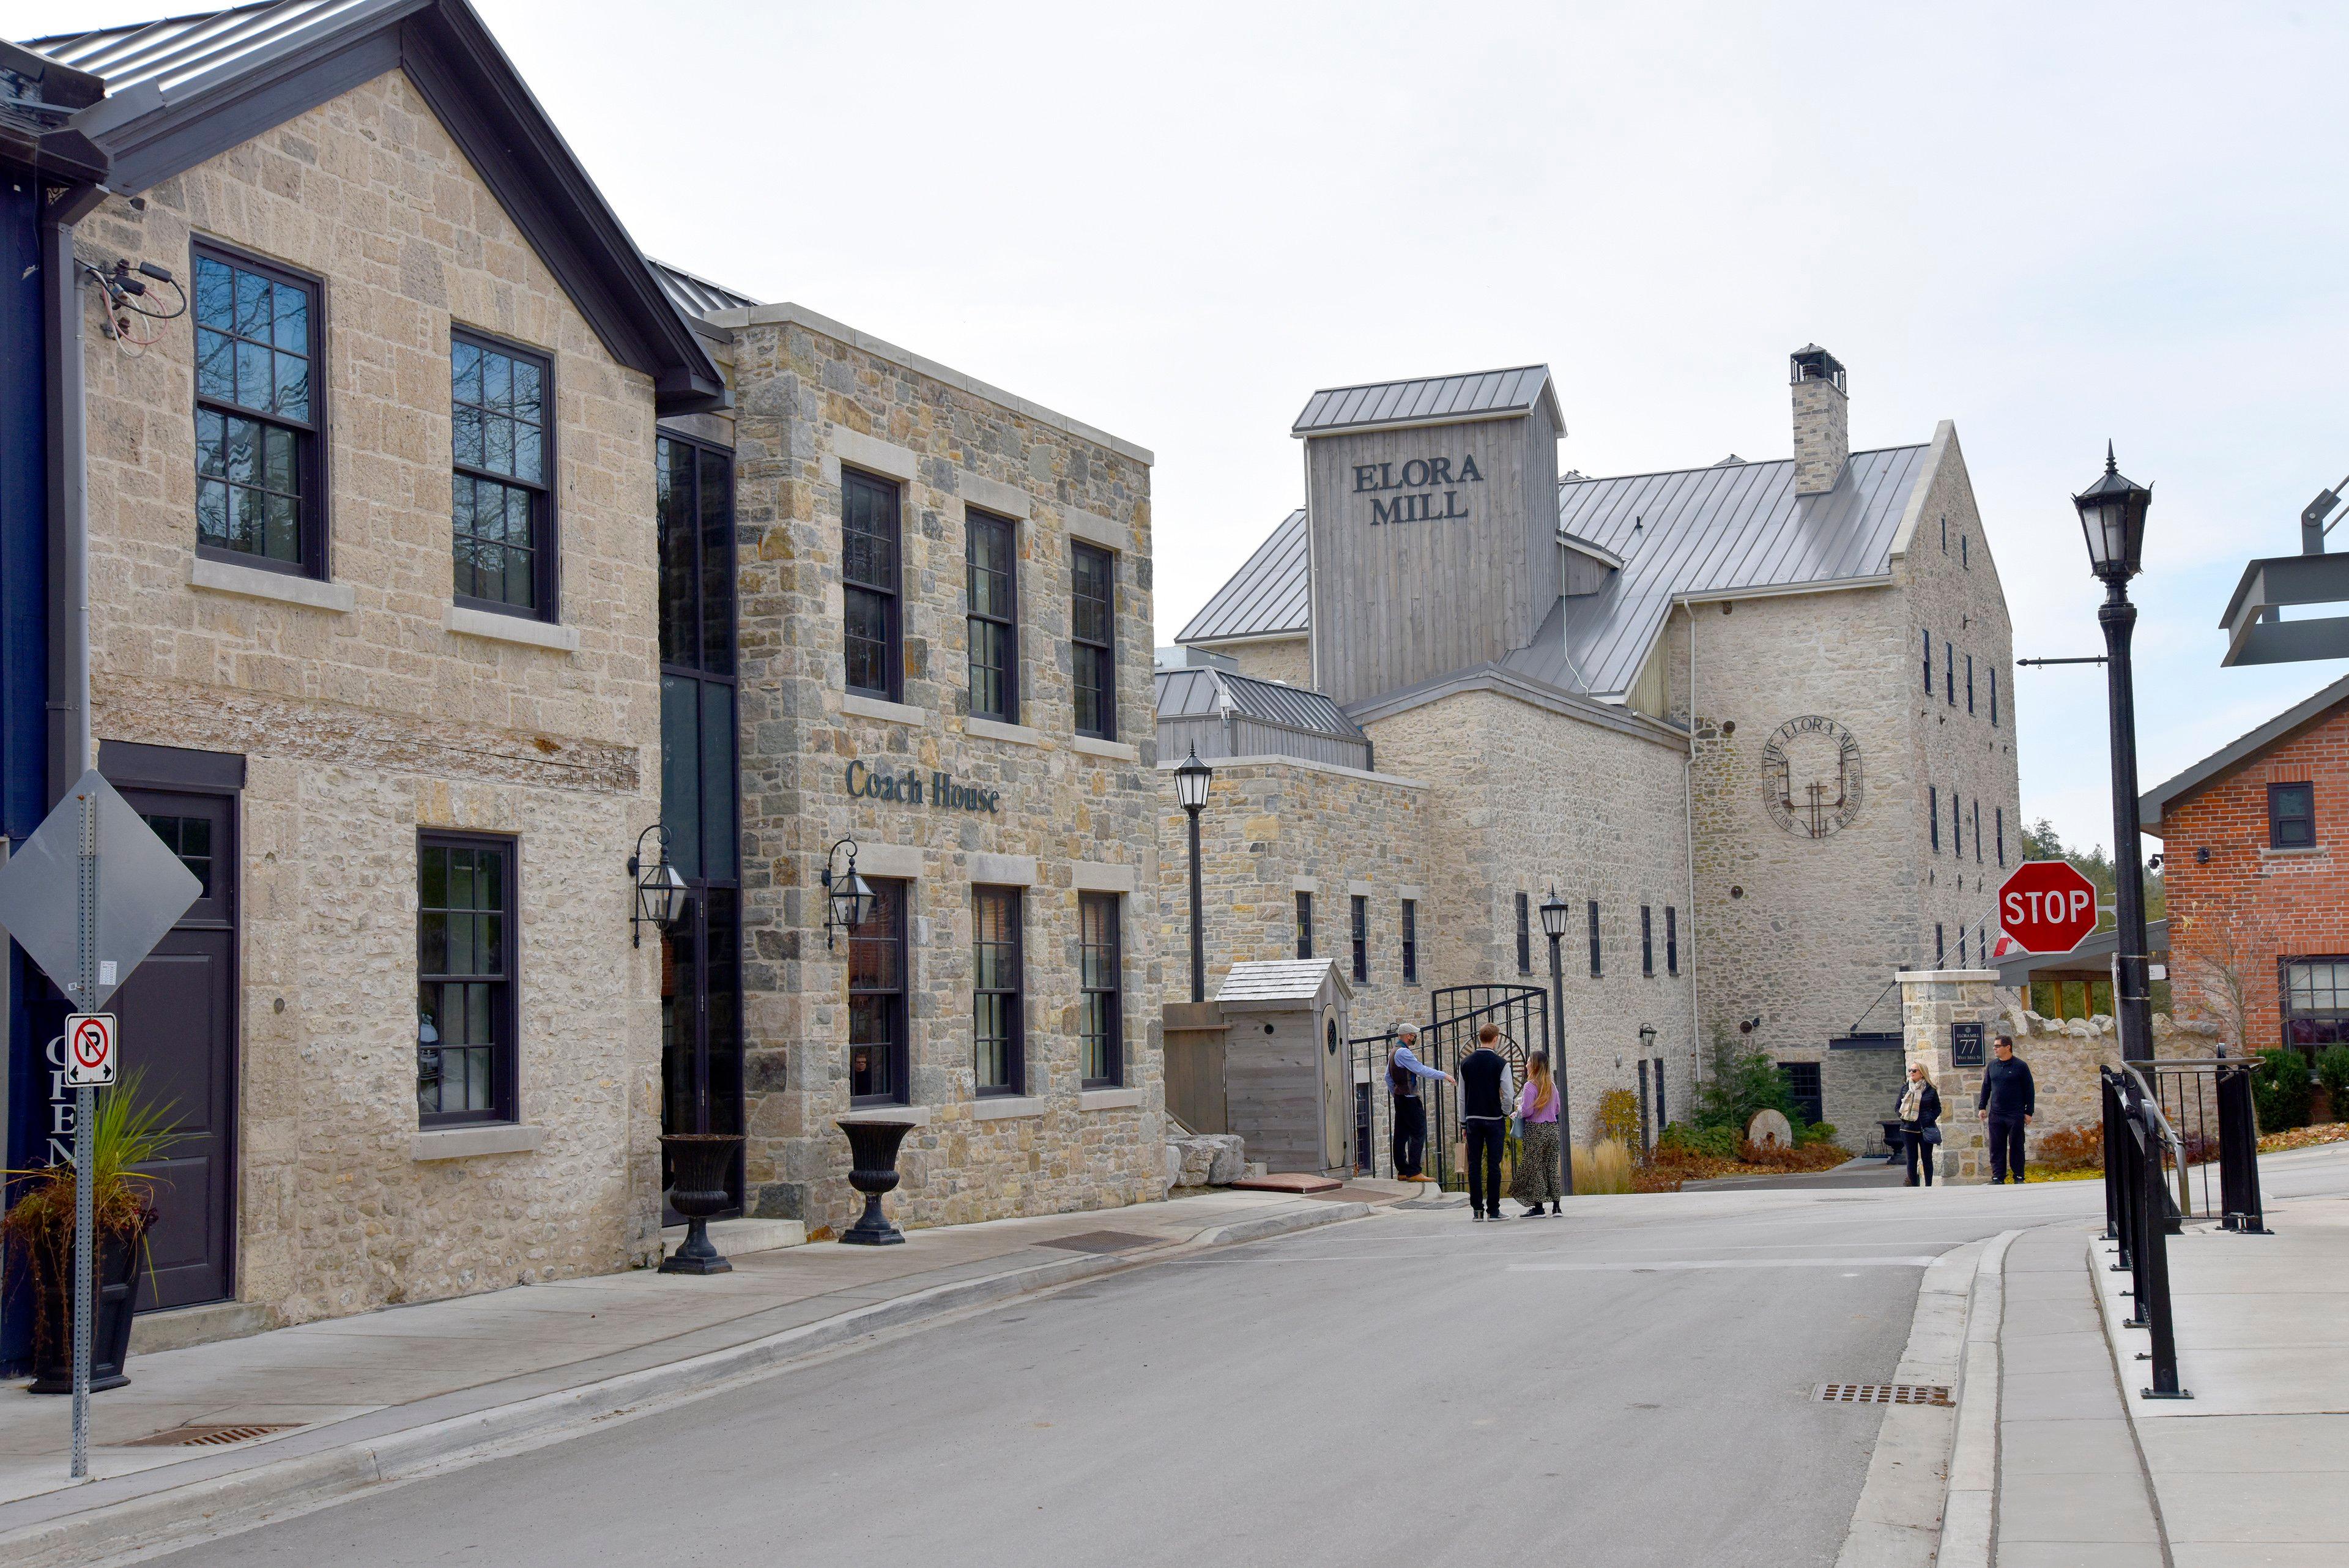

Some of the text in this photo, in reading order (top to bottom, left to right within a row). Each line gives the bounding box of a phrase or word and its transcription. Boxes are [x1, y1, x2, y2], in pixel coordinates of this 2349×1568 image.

[1352, 454, 1484, 492] ELORA
[1370, 491, 1468, 525] MILL
[1764, 718, 1859, 771] THE ELORA MILL
[846, 760, 1000, 814] Coach House
[1767, 775, 1795, 828] COUNTRY INN
[1841, 768, 1858, 819] RESTAURANT
[2005, 890, 2090, 925] STOP
[1960, 1039, 1977, 1054] 77
